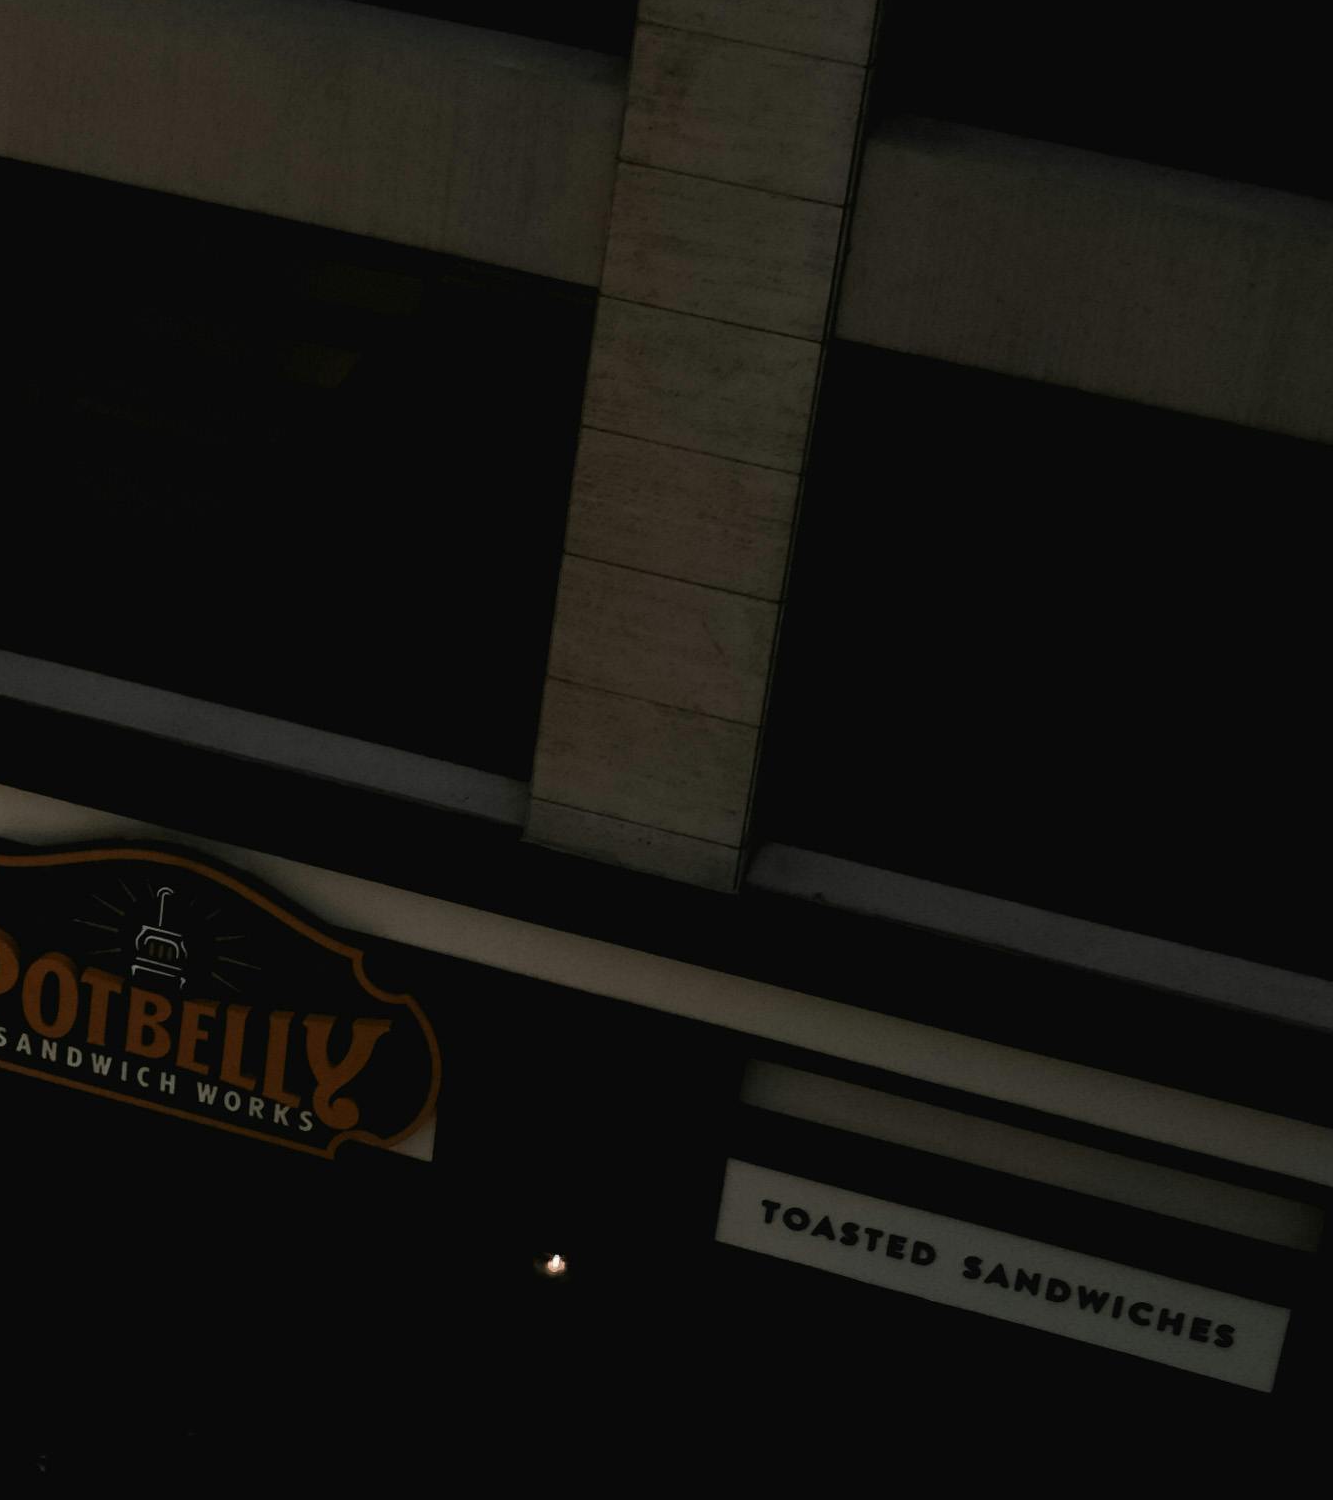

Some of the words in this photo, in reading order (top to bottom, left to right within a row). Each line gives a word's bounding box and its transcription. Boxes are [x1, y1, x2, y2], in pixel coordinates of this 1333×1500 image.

[196, 1081, 316, 1134] WORKS
[760, 1198, 937, 1268] TOASTED
[962, 1255, 1237, 1350] SANDWICHES
